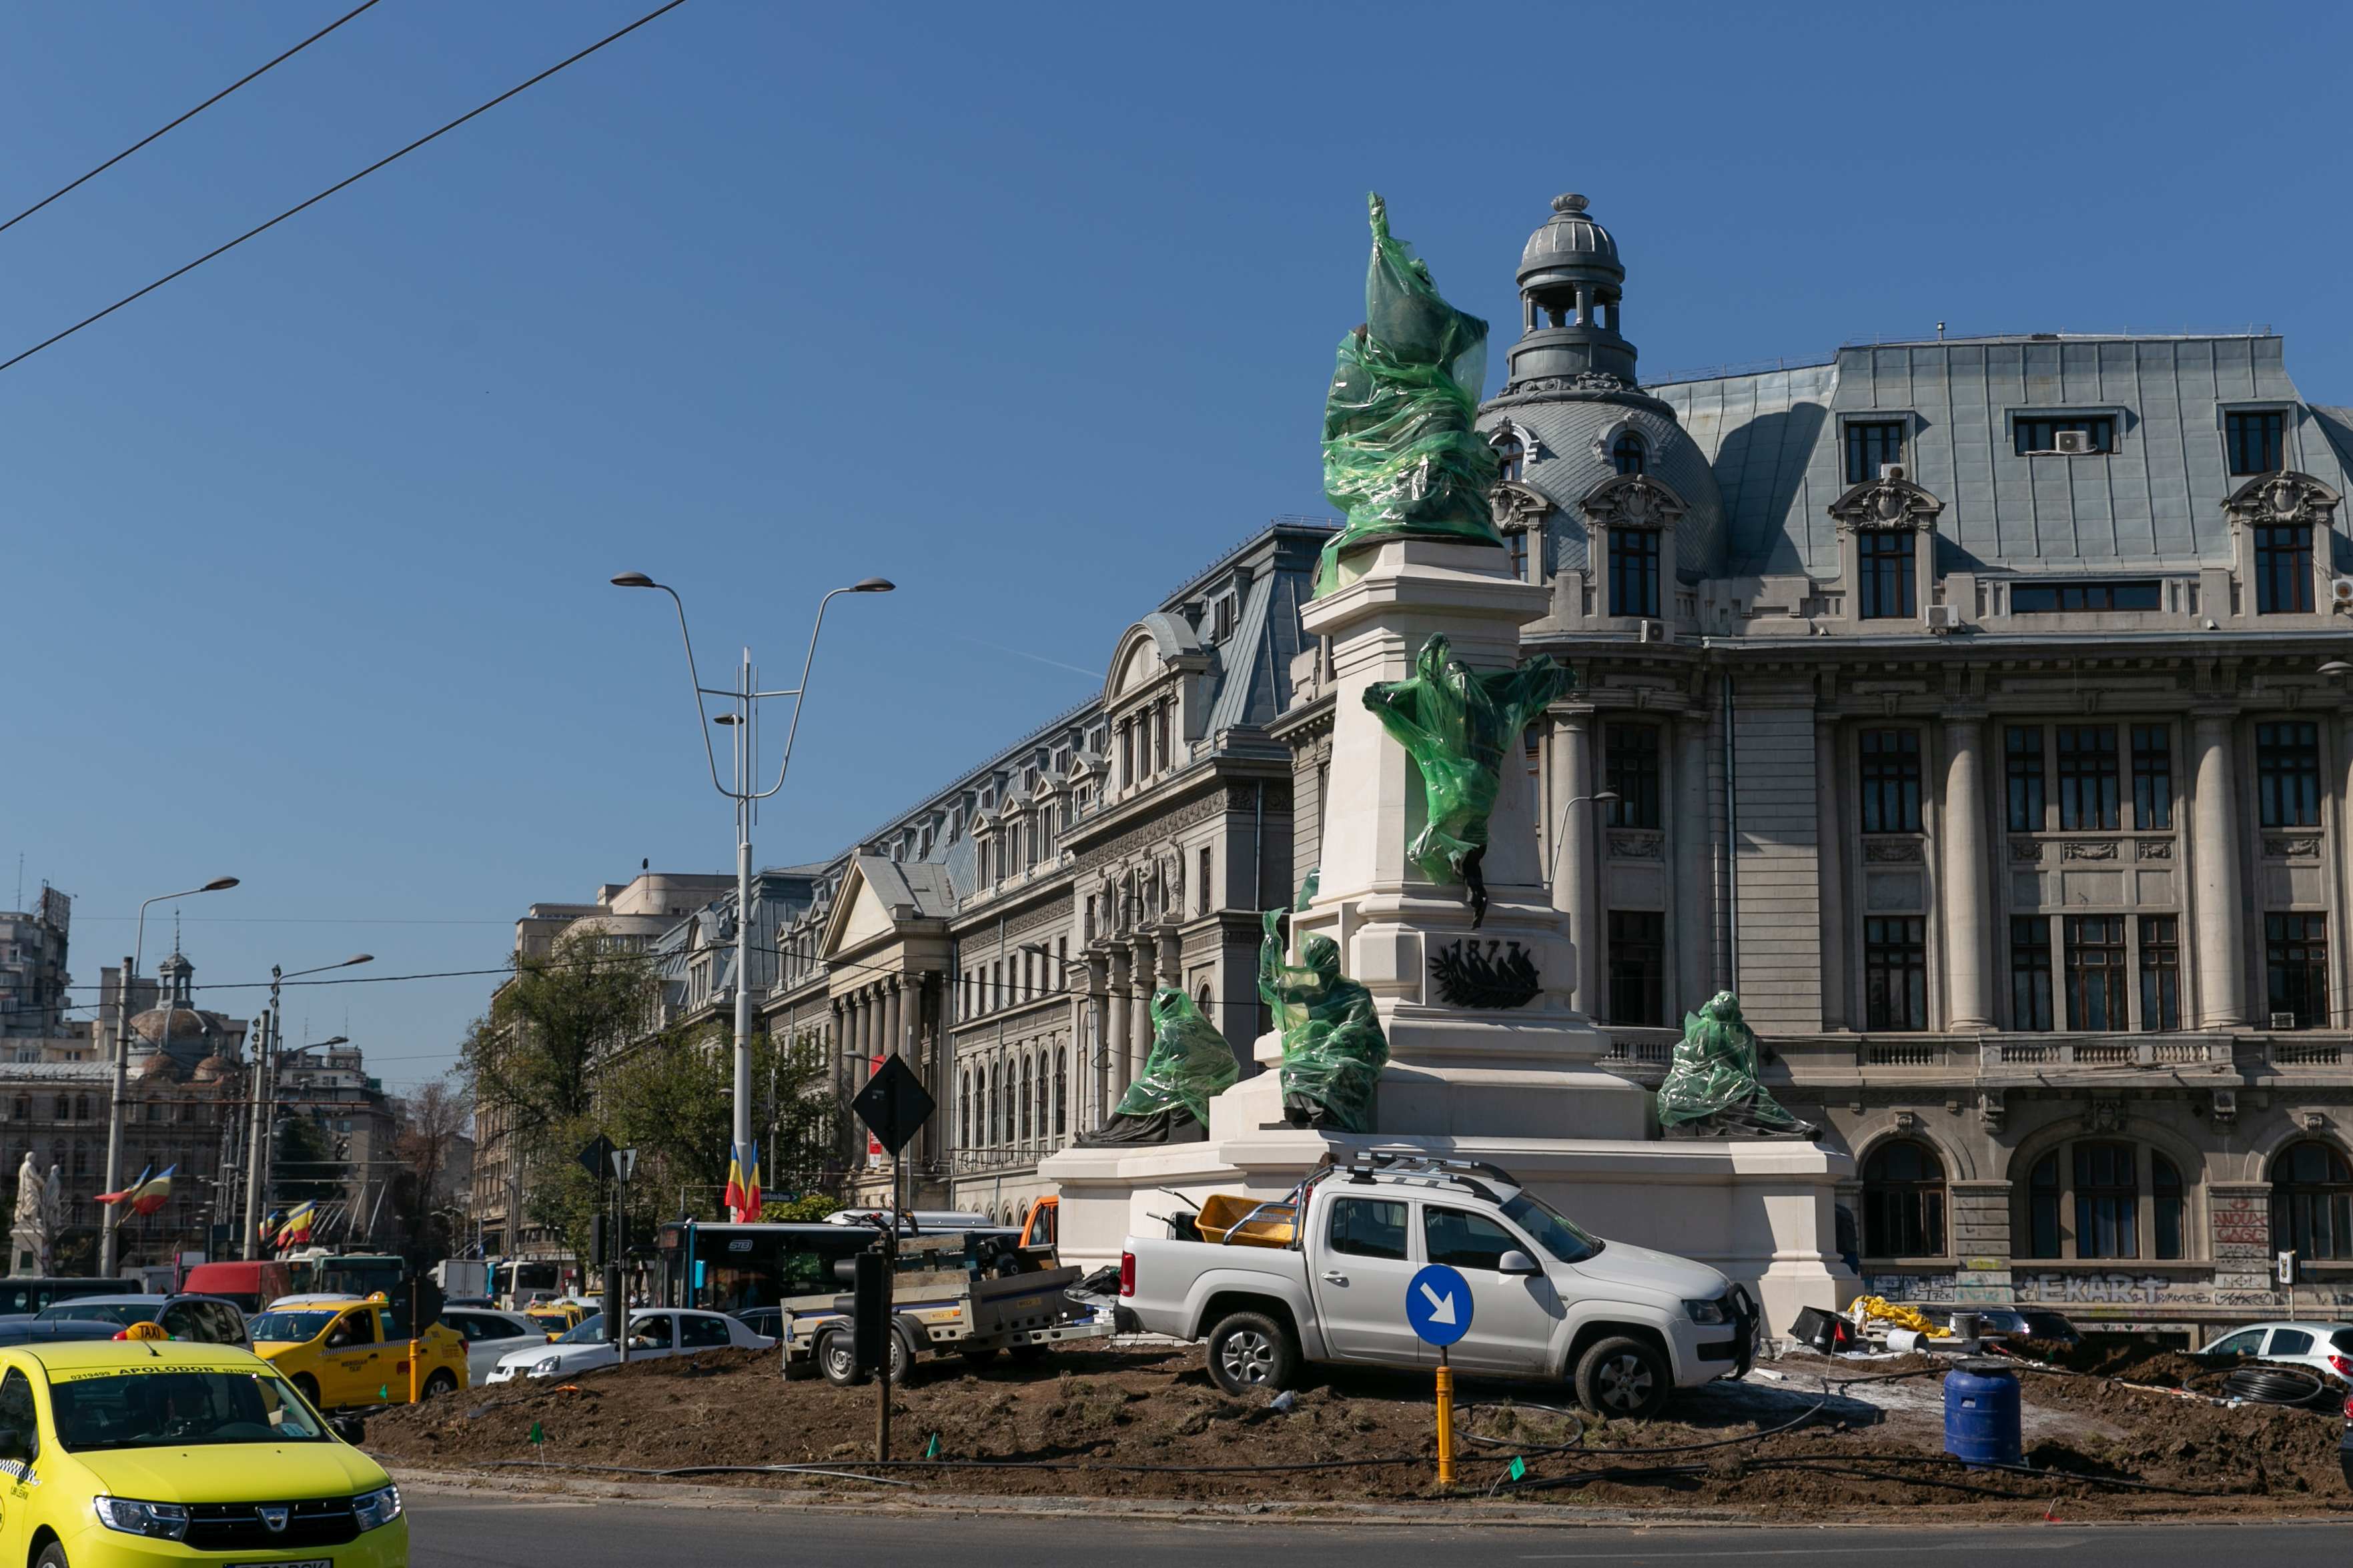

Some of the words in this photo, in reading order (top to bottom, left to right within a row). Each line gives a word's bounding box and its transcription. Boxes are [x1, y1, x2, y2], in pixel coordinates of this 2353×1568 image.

[1450, 938, 1520, 964] 1877
[728, 1241, 751, 1249] STB
[138, 1325, 161, 1339] TAXI
[341, 1359, 368, 1367] MERIDIAN
[119, 1366, 215, 1375] APOLODOR
